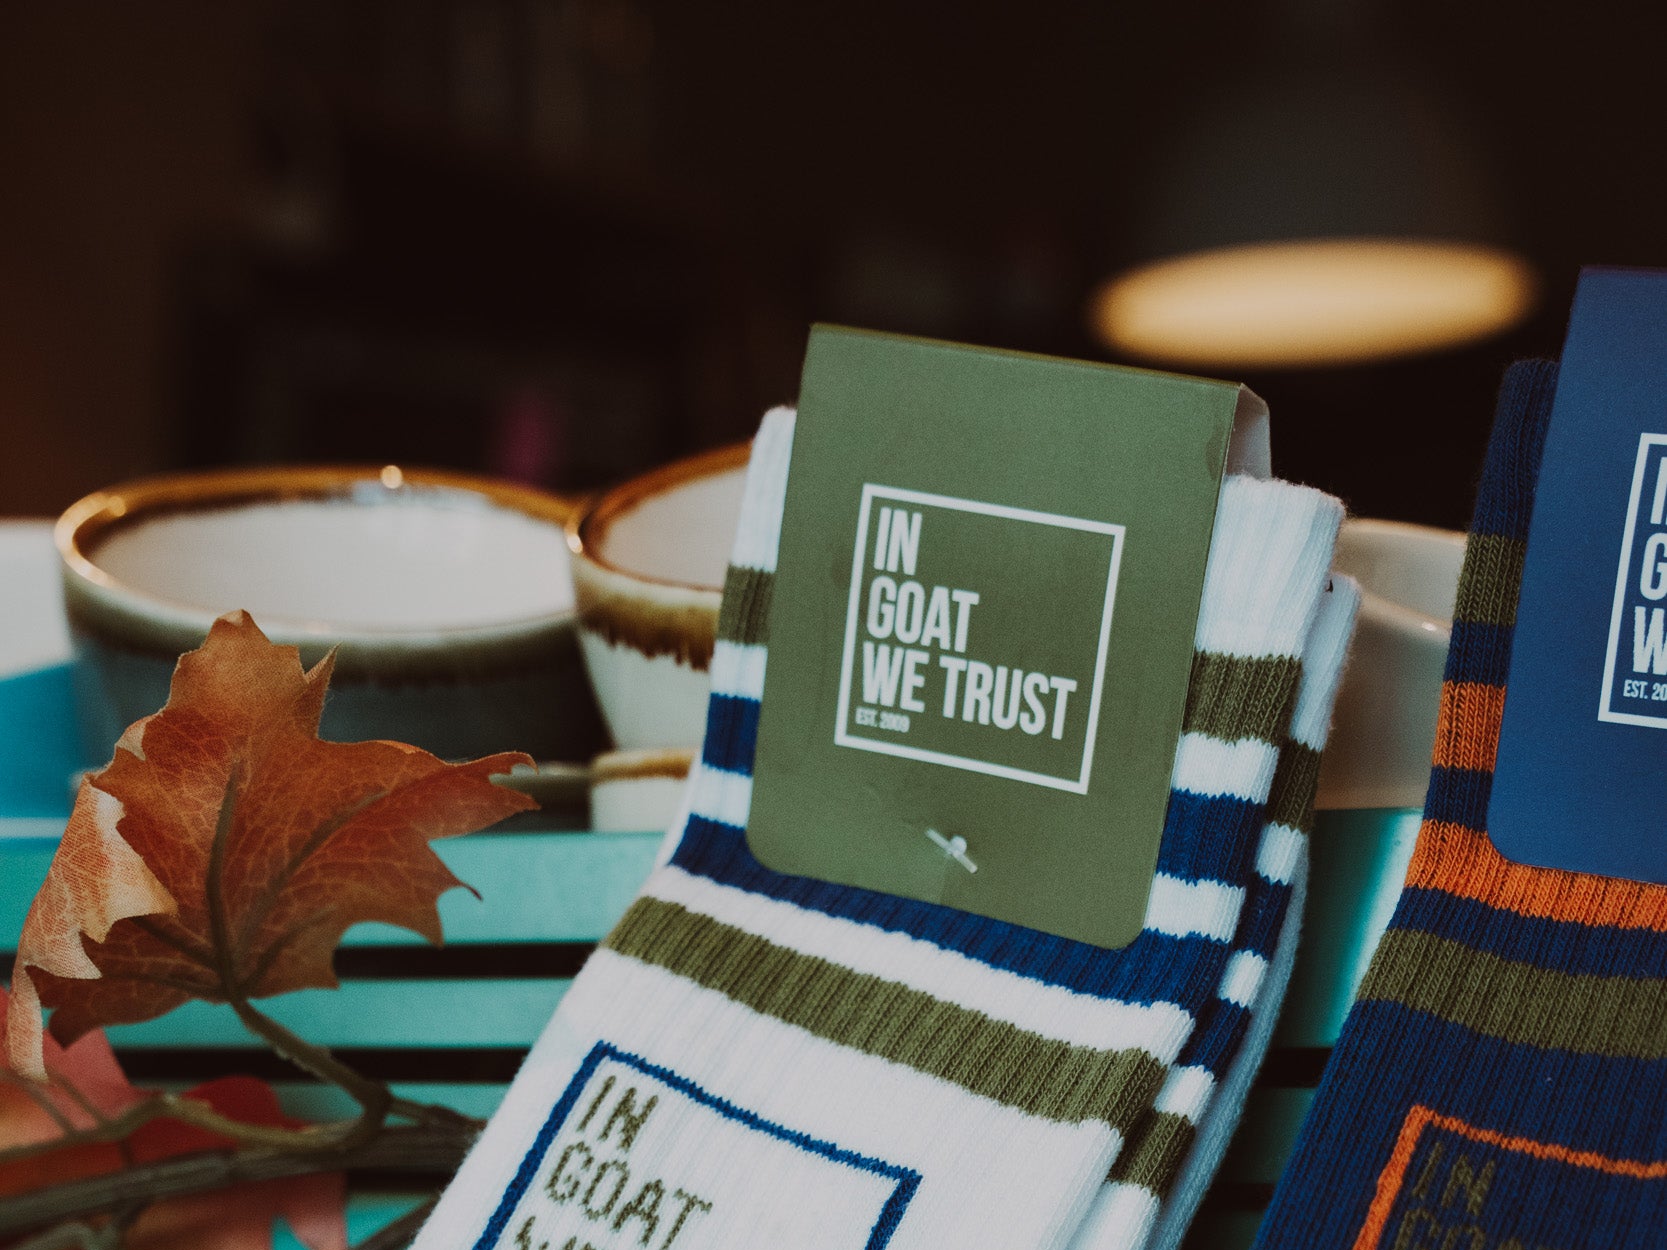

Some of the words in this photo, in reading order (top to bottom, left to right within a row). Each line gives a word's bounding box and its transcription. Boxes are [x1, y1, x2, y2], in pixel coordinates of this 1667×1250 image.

[873, 506, 923, 576] IN
[866, 575, 980, 653] GOAT
[863, 641, 930, 713] WE
[939, 655, 1077, 741] TRUST
[1623, 679, 1649, 700] EST.
[577, 1075, 660, 1152] IN
[1411, 1141, 1496, 1217] IN
